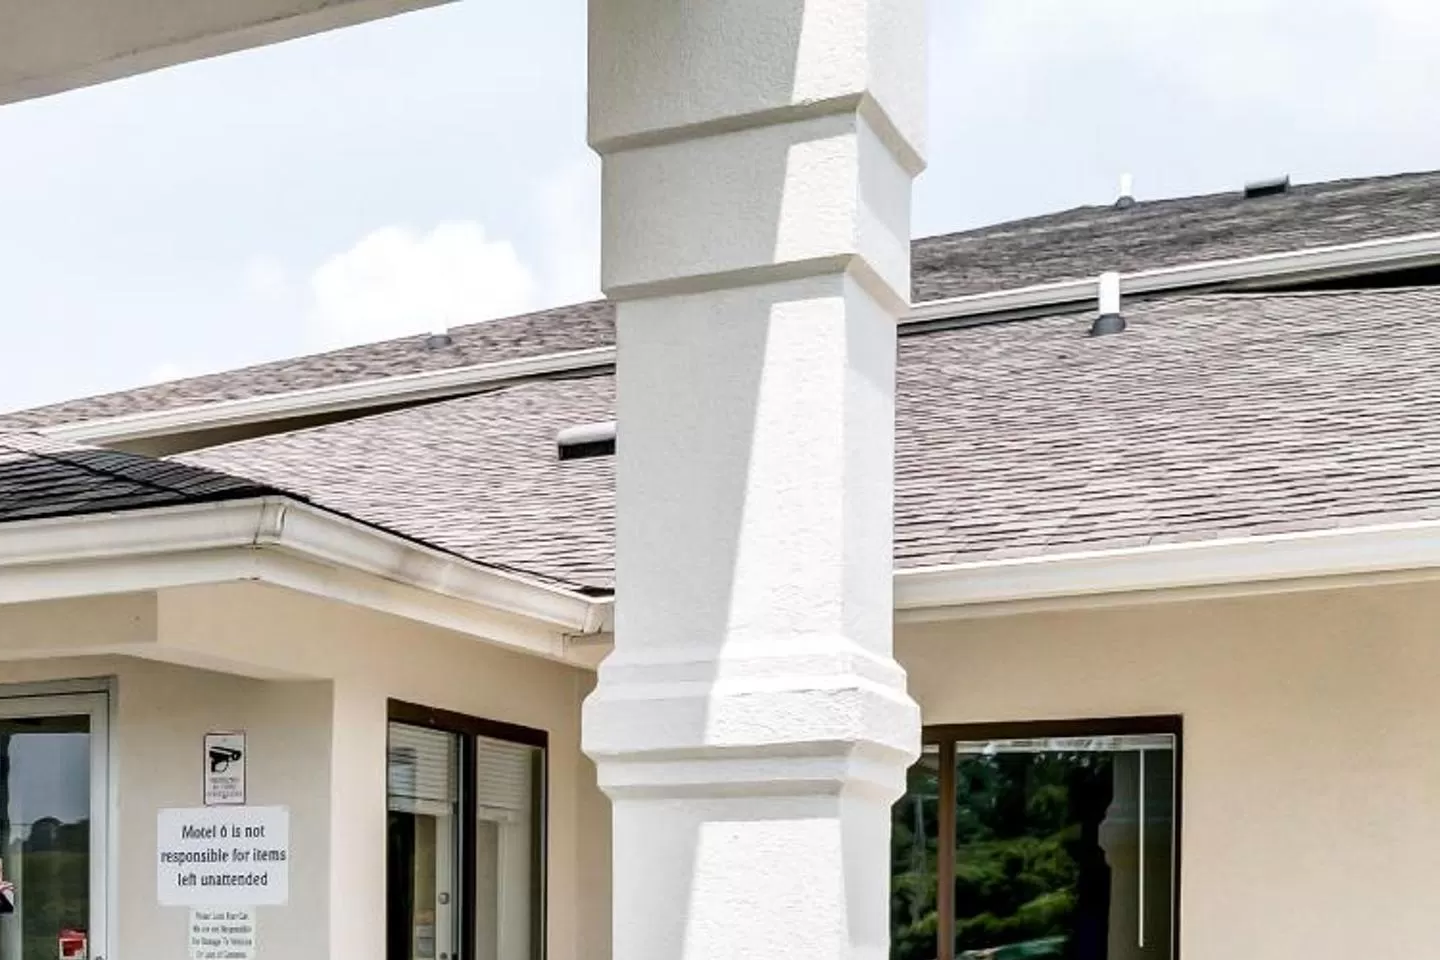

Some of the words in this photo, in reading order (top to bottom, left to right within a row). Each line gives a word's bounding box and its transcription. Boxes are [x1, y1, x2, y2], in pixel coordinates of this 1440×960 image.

[182, 824, 216, 839] Motel
[220, 825, 227, 838] 6
[232, 824, 241, 838] is
[245, 825, 265, 838] not
[160, 848, 229, 865] responsible
[232, 848, 250, 862] for
[253, 848, 286, 861] items
[178, 872, 197, 886] left
[201, 871, 268, 886] unattended
